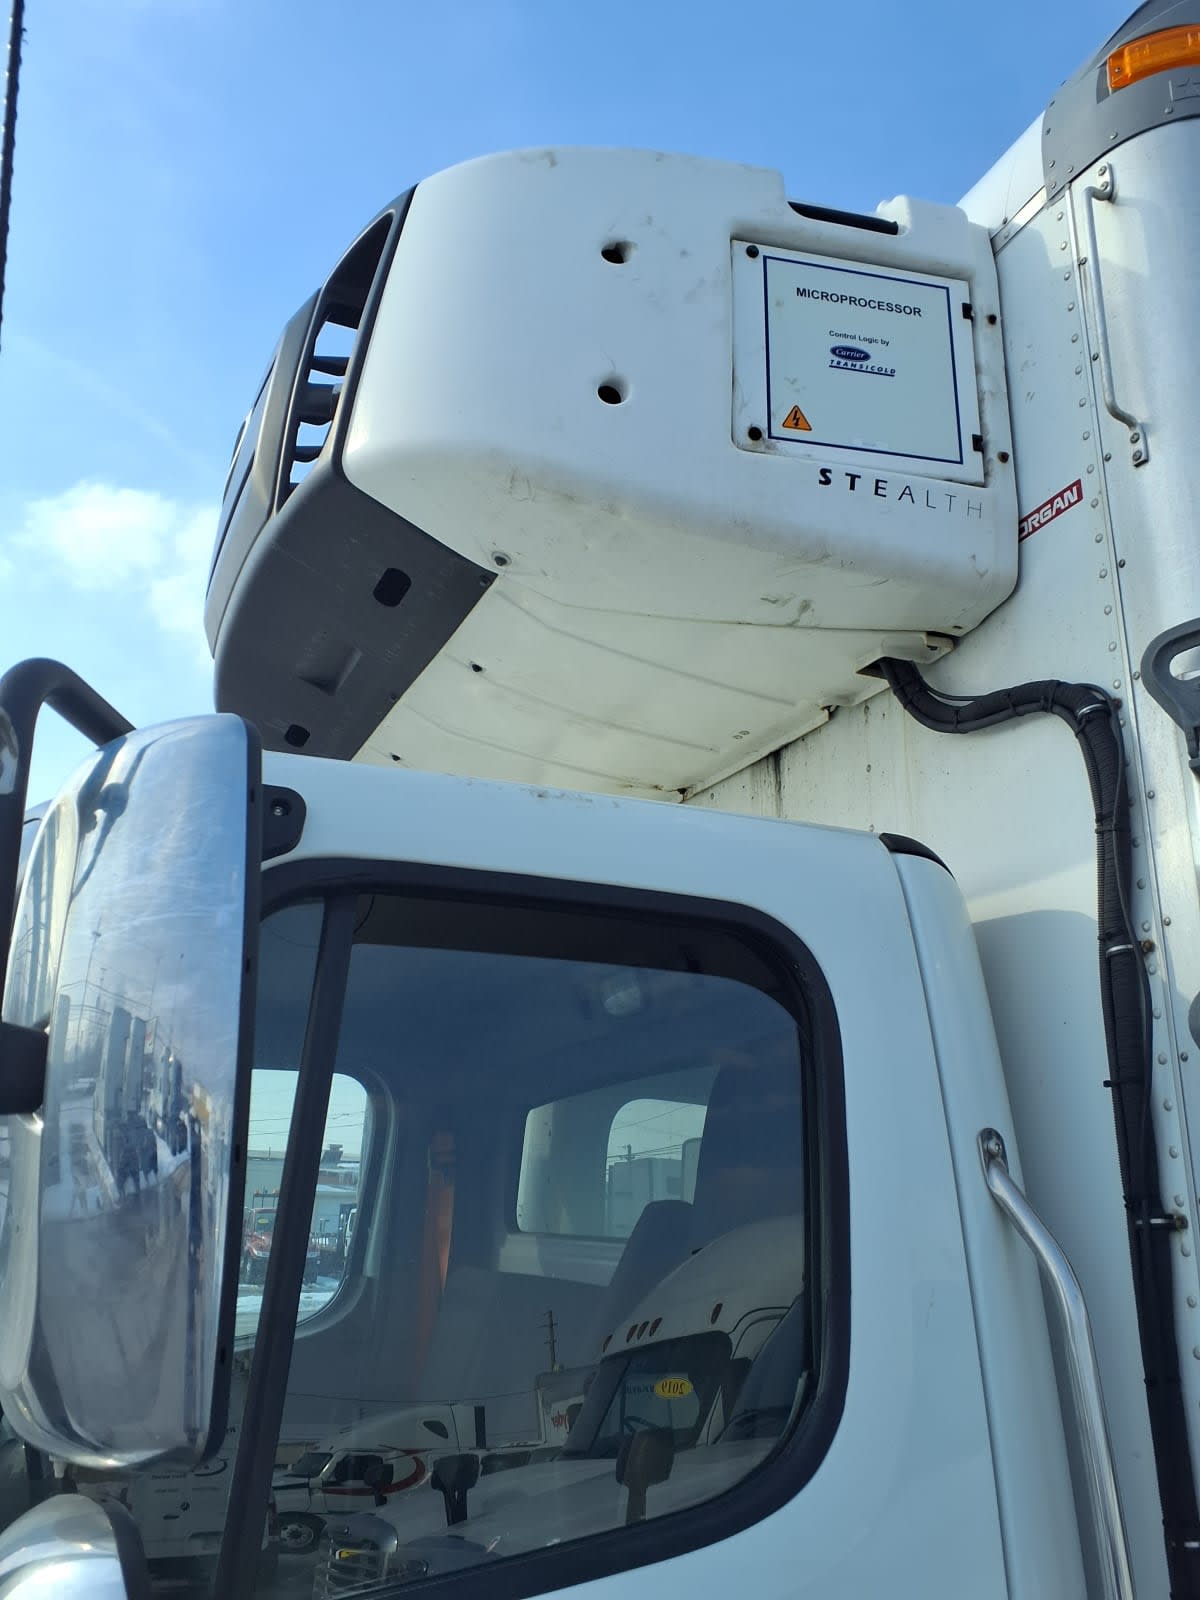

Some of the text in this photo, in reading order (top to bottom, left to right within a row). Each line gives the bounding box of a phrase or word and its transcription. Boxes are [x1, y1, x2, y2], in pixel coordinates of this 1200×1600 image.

[796, 287, 922, 317] MICROPROCESSOR
[829, 330, 890, 346] Control Logic by
[835, 348, 866, 360] Carrier
[829, 359, 896, 374] TRANSICOLD
[818, 467, 983, 519] STEALTH
[1019, 485, 1079, 538] ORGAN
